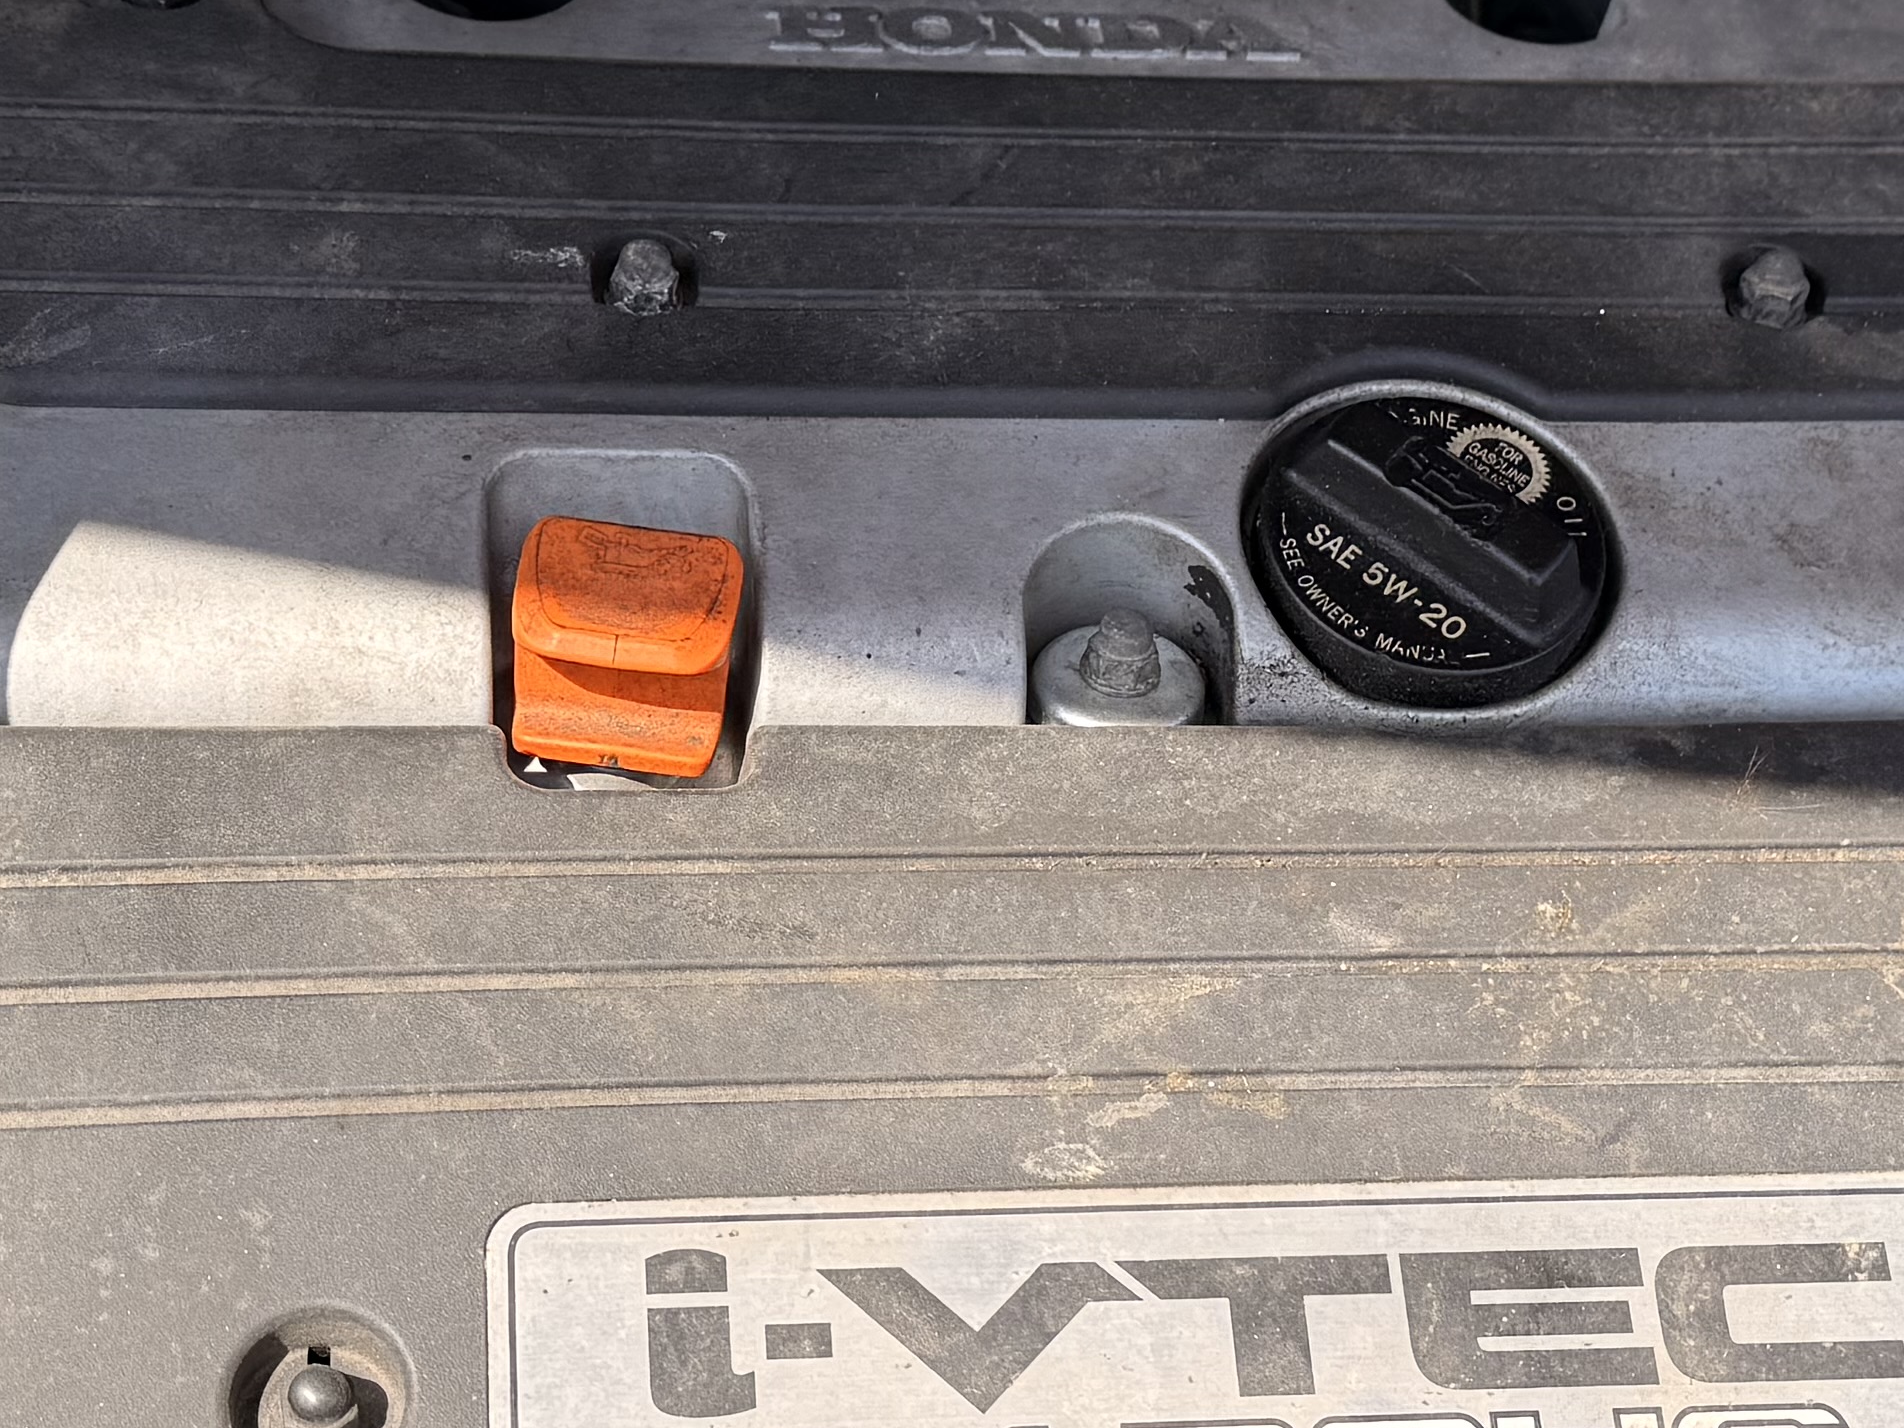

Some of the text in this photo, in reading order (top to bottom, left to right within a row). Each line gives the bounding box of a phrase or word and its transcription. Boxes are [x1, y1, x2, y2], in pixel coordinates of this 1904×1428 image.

[764, 4, 1302, 62] HONDA
[1468, 442, 1531, 489] GASOLINE
[1494, 440, 1524, 464] FOR
[1297, 573, 1369, 638] OWNER'S
[1306, 522, 1468, 641] SAE 5W-20
